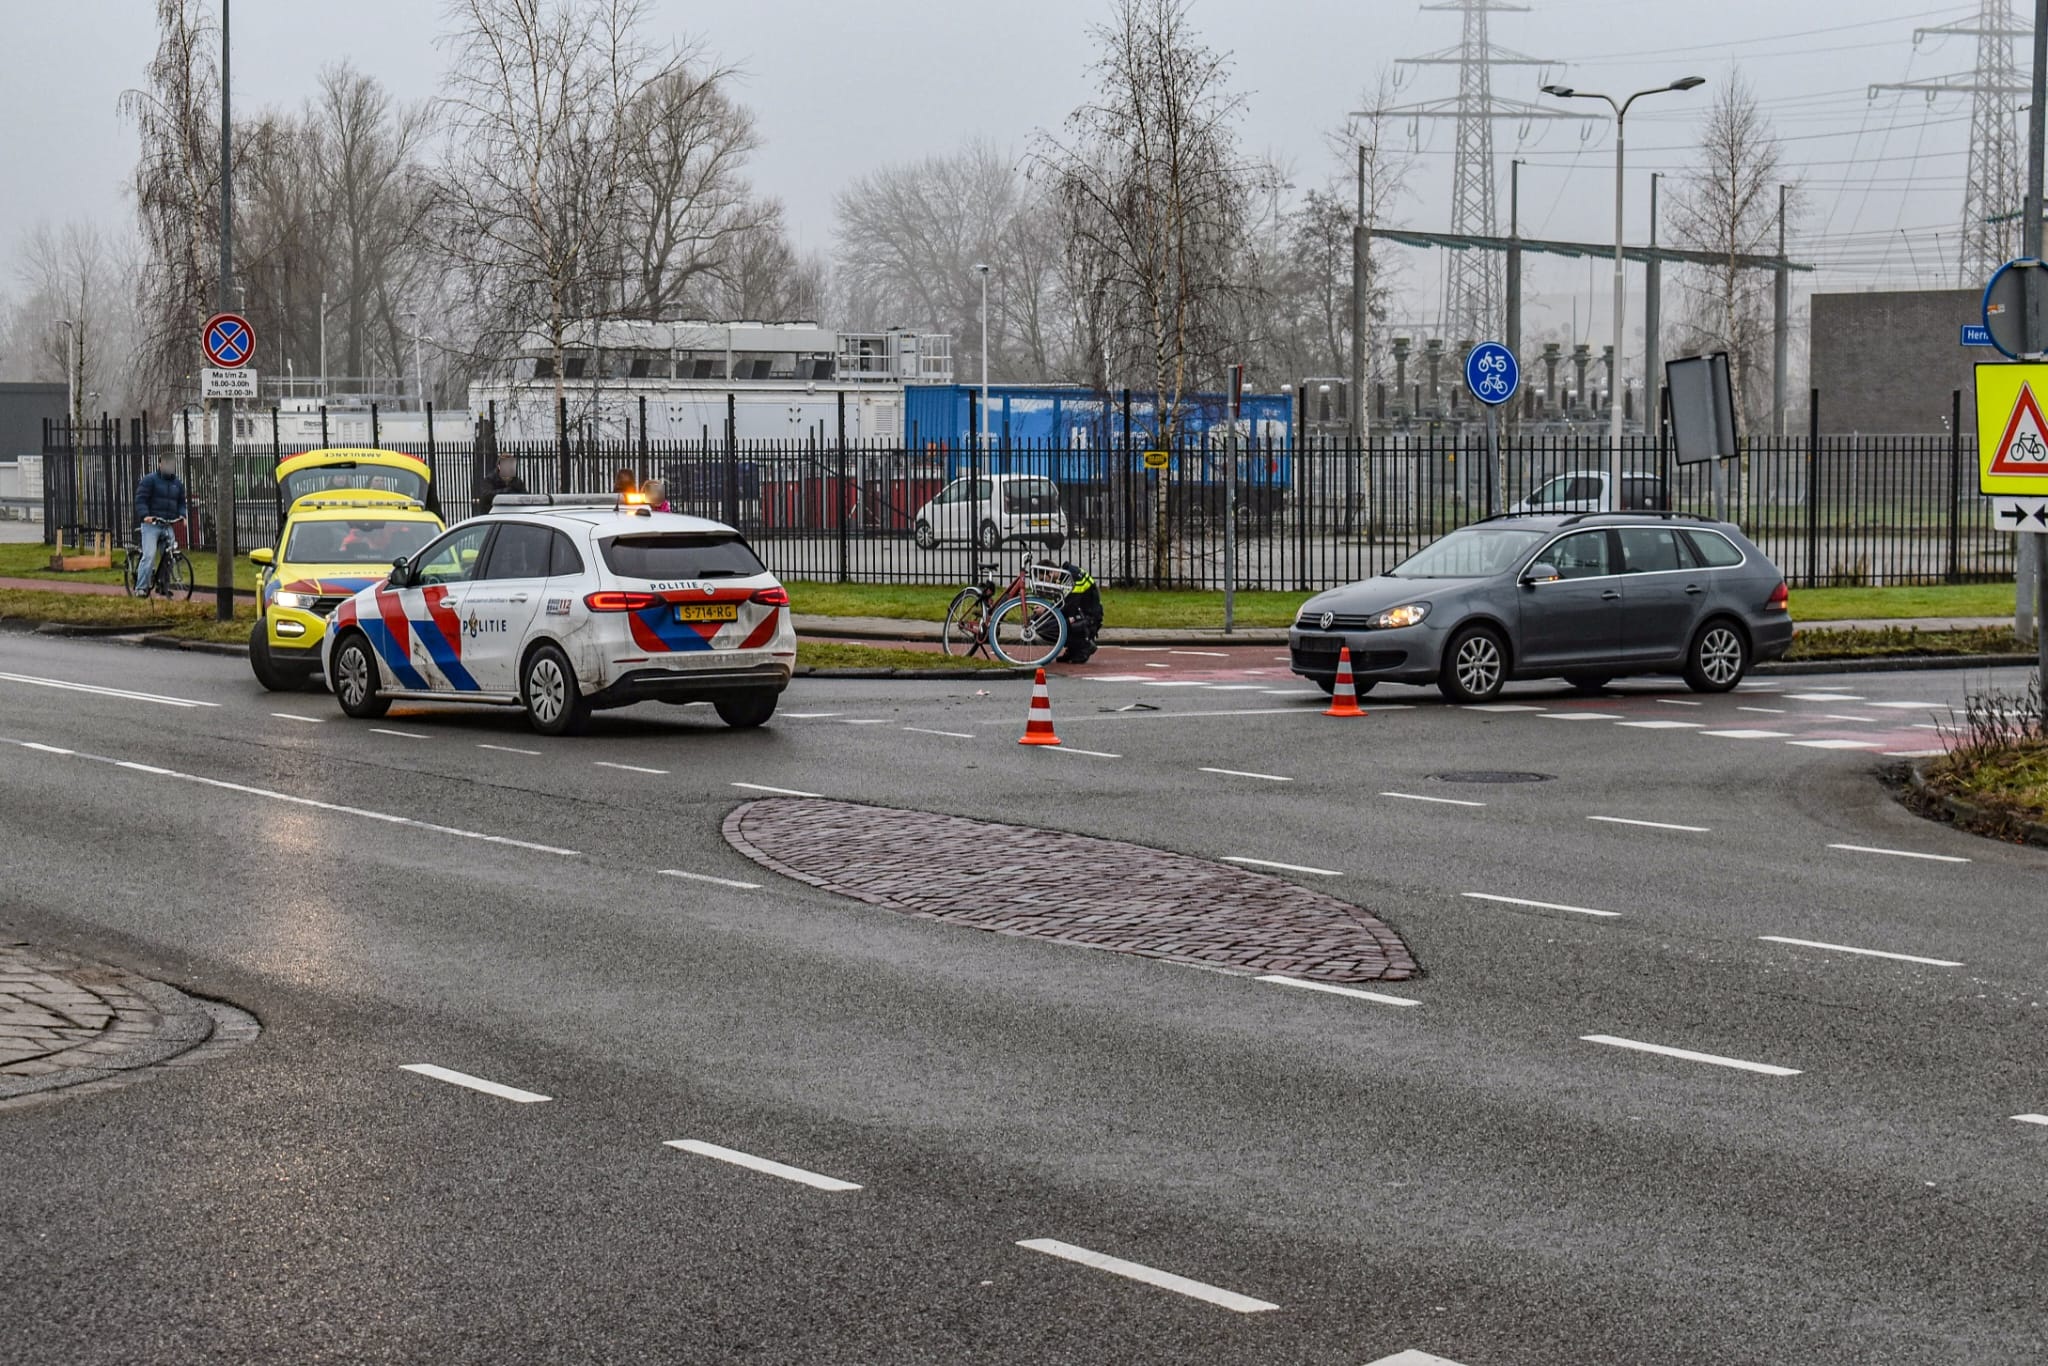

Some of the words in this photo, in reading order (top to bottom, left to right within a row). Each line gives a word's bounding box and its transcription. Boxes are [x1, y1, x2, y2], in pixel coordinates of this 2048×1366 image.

[650, 581, 699, 591] POLITIE
[559, 599, 572, 609] 112
[684, 605, 732, 619] S-714-RG
[462, 618, 507, 638] POLITIE
